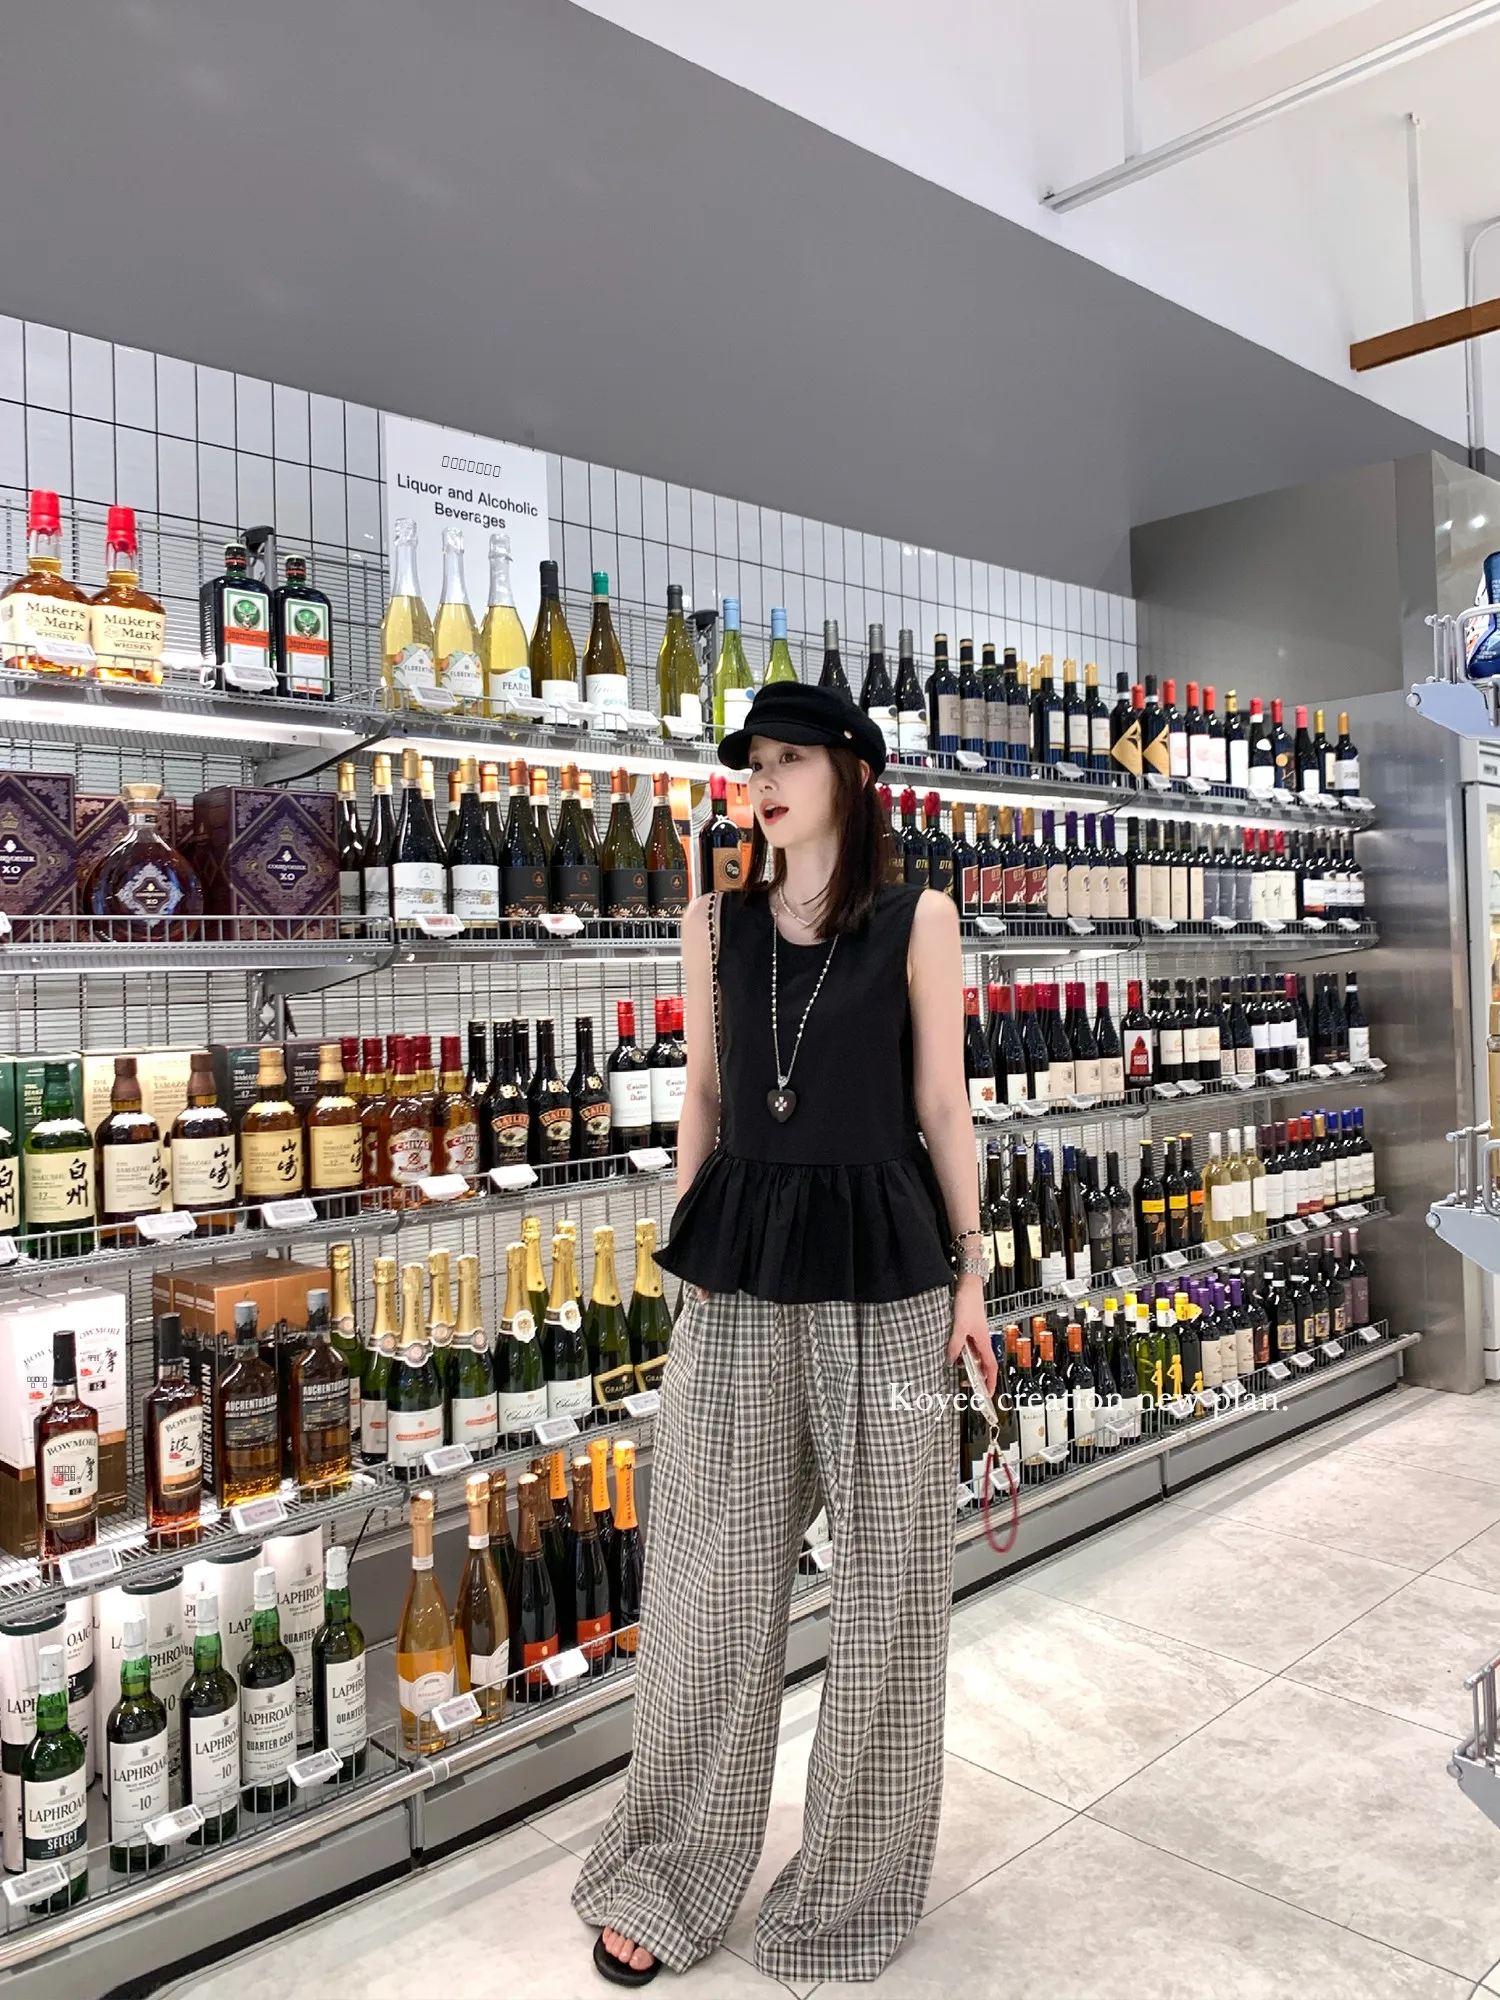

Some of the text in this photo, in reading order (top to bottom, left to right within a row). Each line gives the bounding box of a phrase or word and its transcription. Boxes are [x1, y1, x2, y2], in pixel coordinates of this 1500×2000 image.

[397, 473, 539, 517] Liquor and Alcoholic
[434, 502, 506, 529] Beverages
[25, 601, 86, 620] Maker's
[44, 616, 84, 632] Mark
[103, 613, 162, 630] Maker's
[35, 631, 77, 642] WHISKY
[122, 628, 161, 642] Mark
[113, 641, 154, 652] WHISKY
[2, 865, 21, 874] XO
[280, 872, 295, 882] XO
[208, 1143, 233, 1191] 山崎
[278, 1138, 299, 1182] 山崎
[67, 1157, 88, 1208] 白州
[202, 1363, 213, 1485] AUCHENTOSHAN
[284, 1629, 315, 1645] QUARTER
[247, 1731, 294, 1751] QUARTER CASK
[222, 1763, 232, 1779] 10
[140, 1794, 152, 1811] 10
[48, 1829, 78, 1851] SELECT
